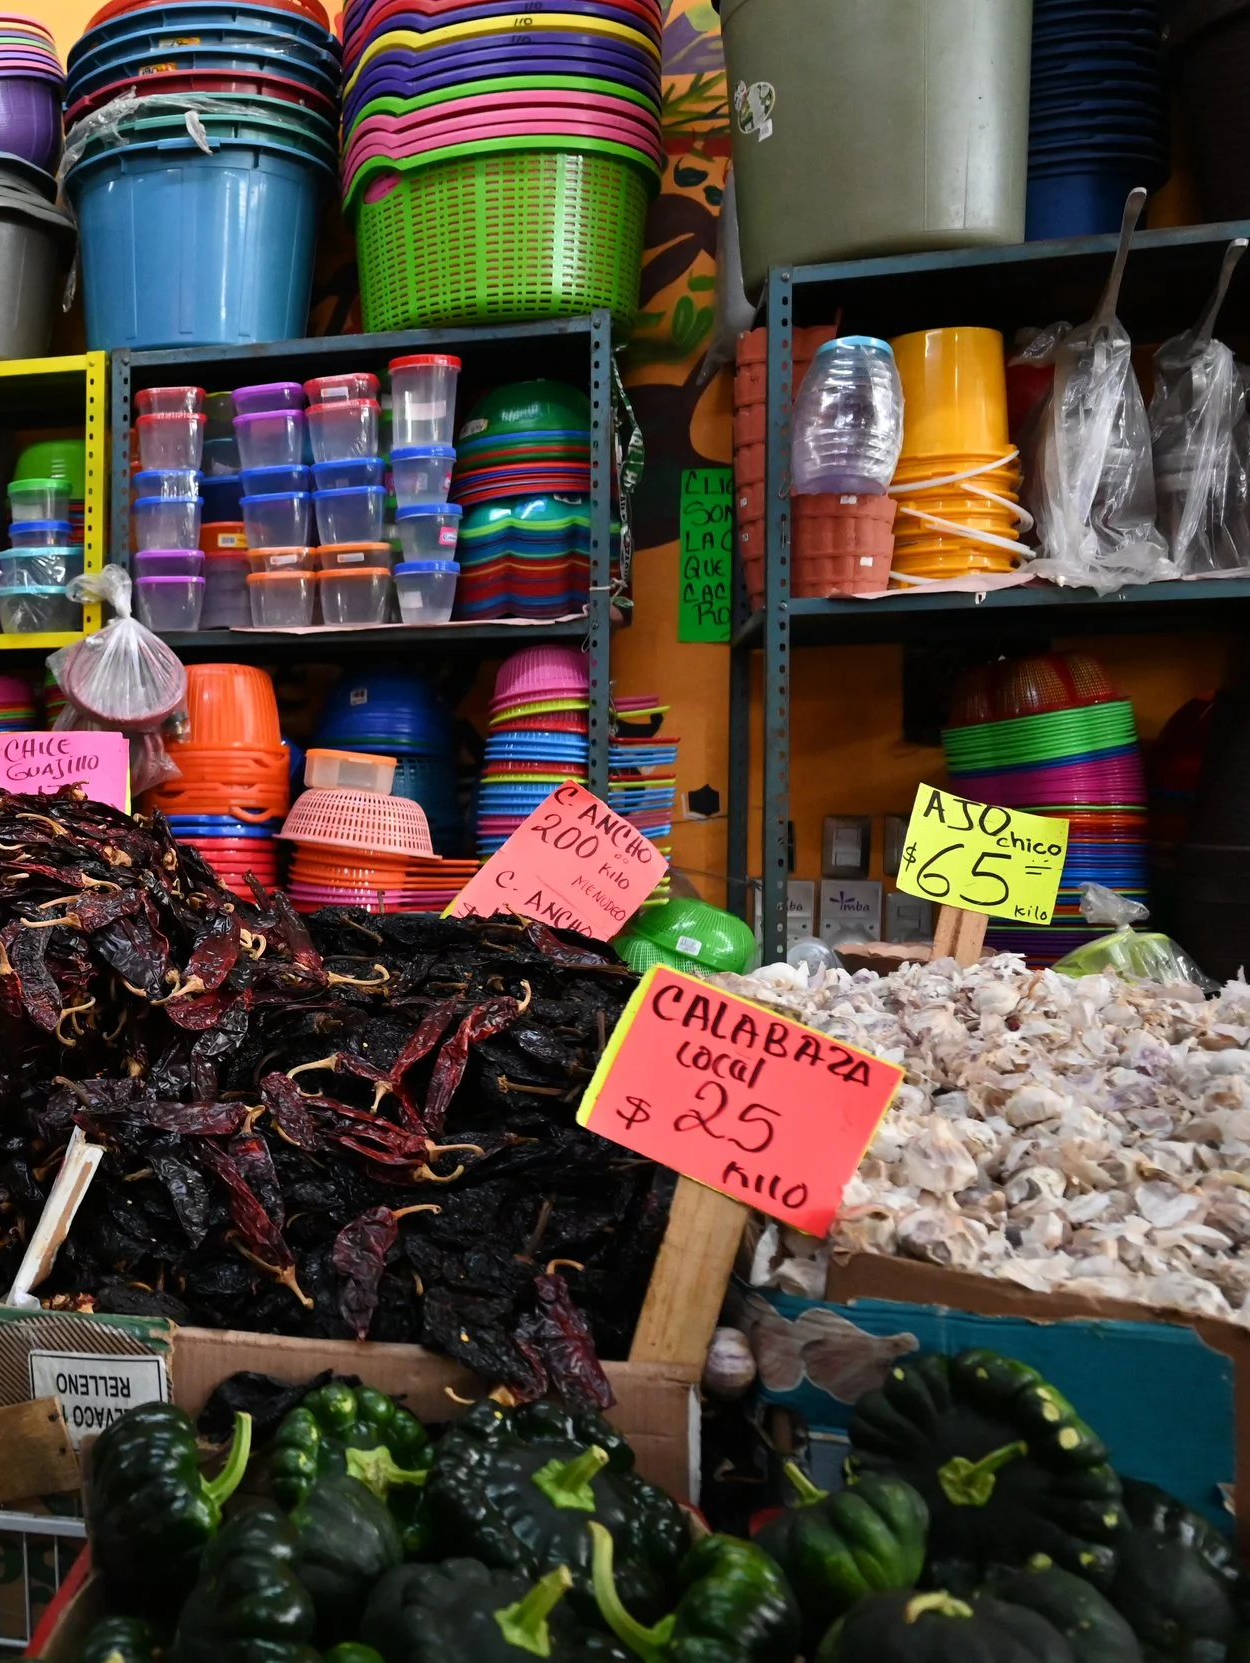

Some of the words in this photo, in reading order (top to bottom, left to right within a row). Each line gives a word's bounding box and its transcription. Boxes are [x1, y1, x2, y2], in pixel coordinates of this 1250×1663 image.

[684, 556, 726, 580] QUE
[4, 737, 71, 762] CHILE
[530, 813, 599, 858] 200
[577, 803, 652, 864] ANCHO
[923, 789, 1012, 836] AJO
[996, 831, 1062, 856] chico
[571, 874, 626, 922] MENUDEO
[652, 985, 870, 1087] CALABAZA
[673, 1081, 782, 1153] 25
[55, 1373, 130, 1399] RELLENO
